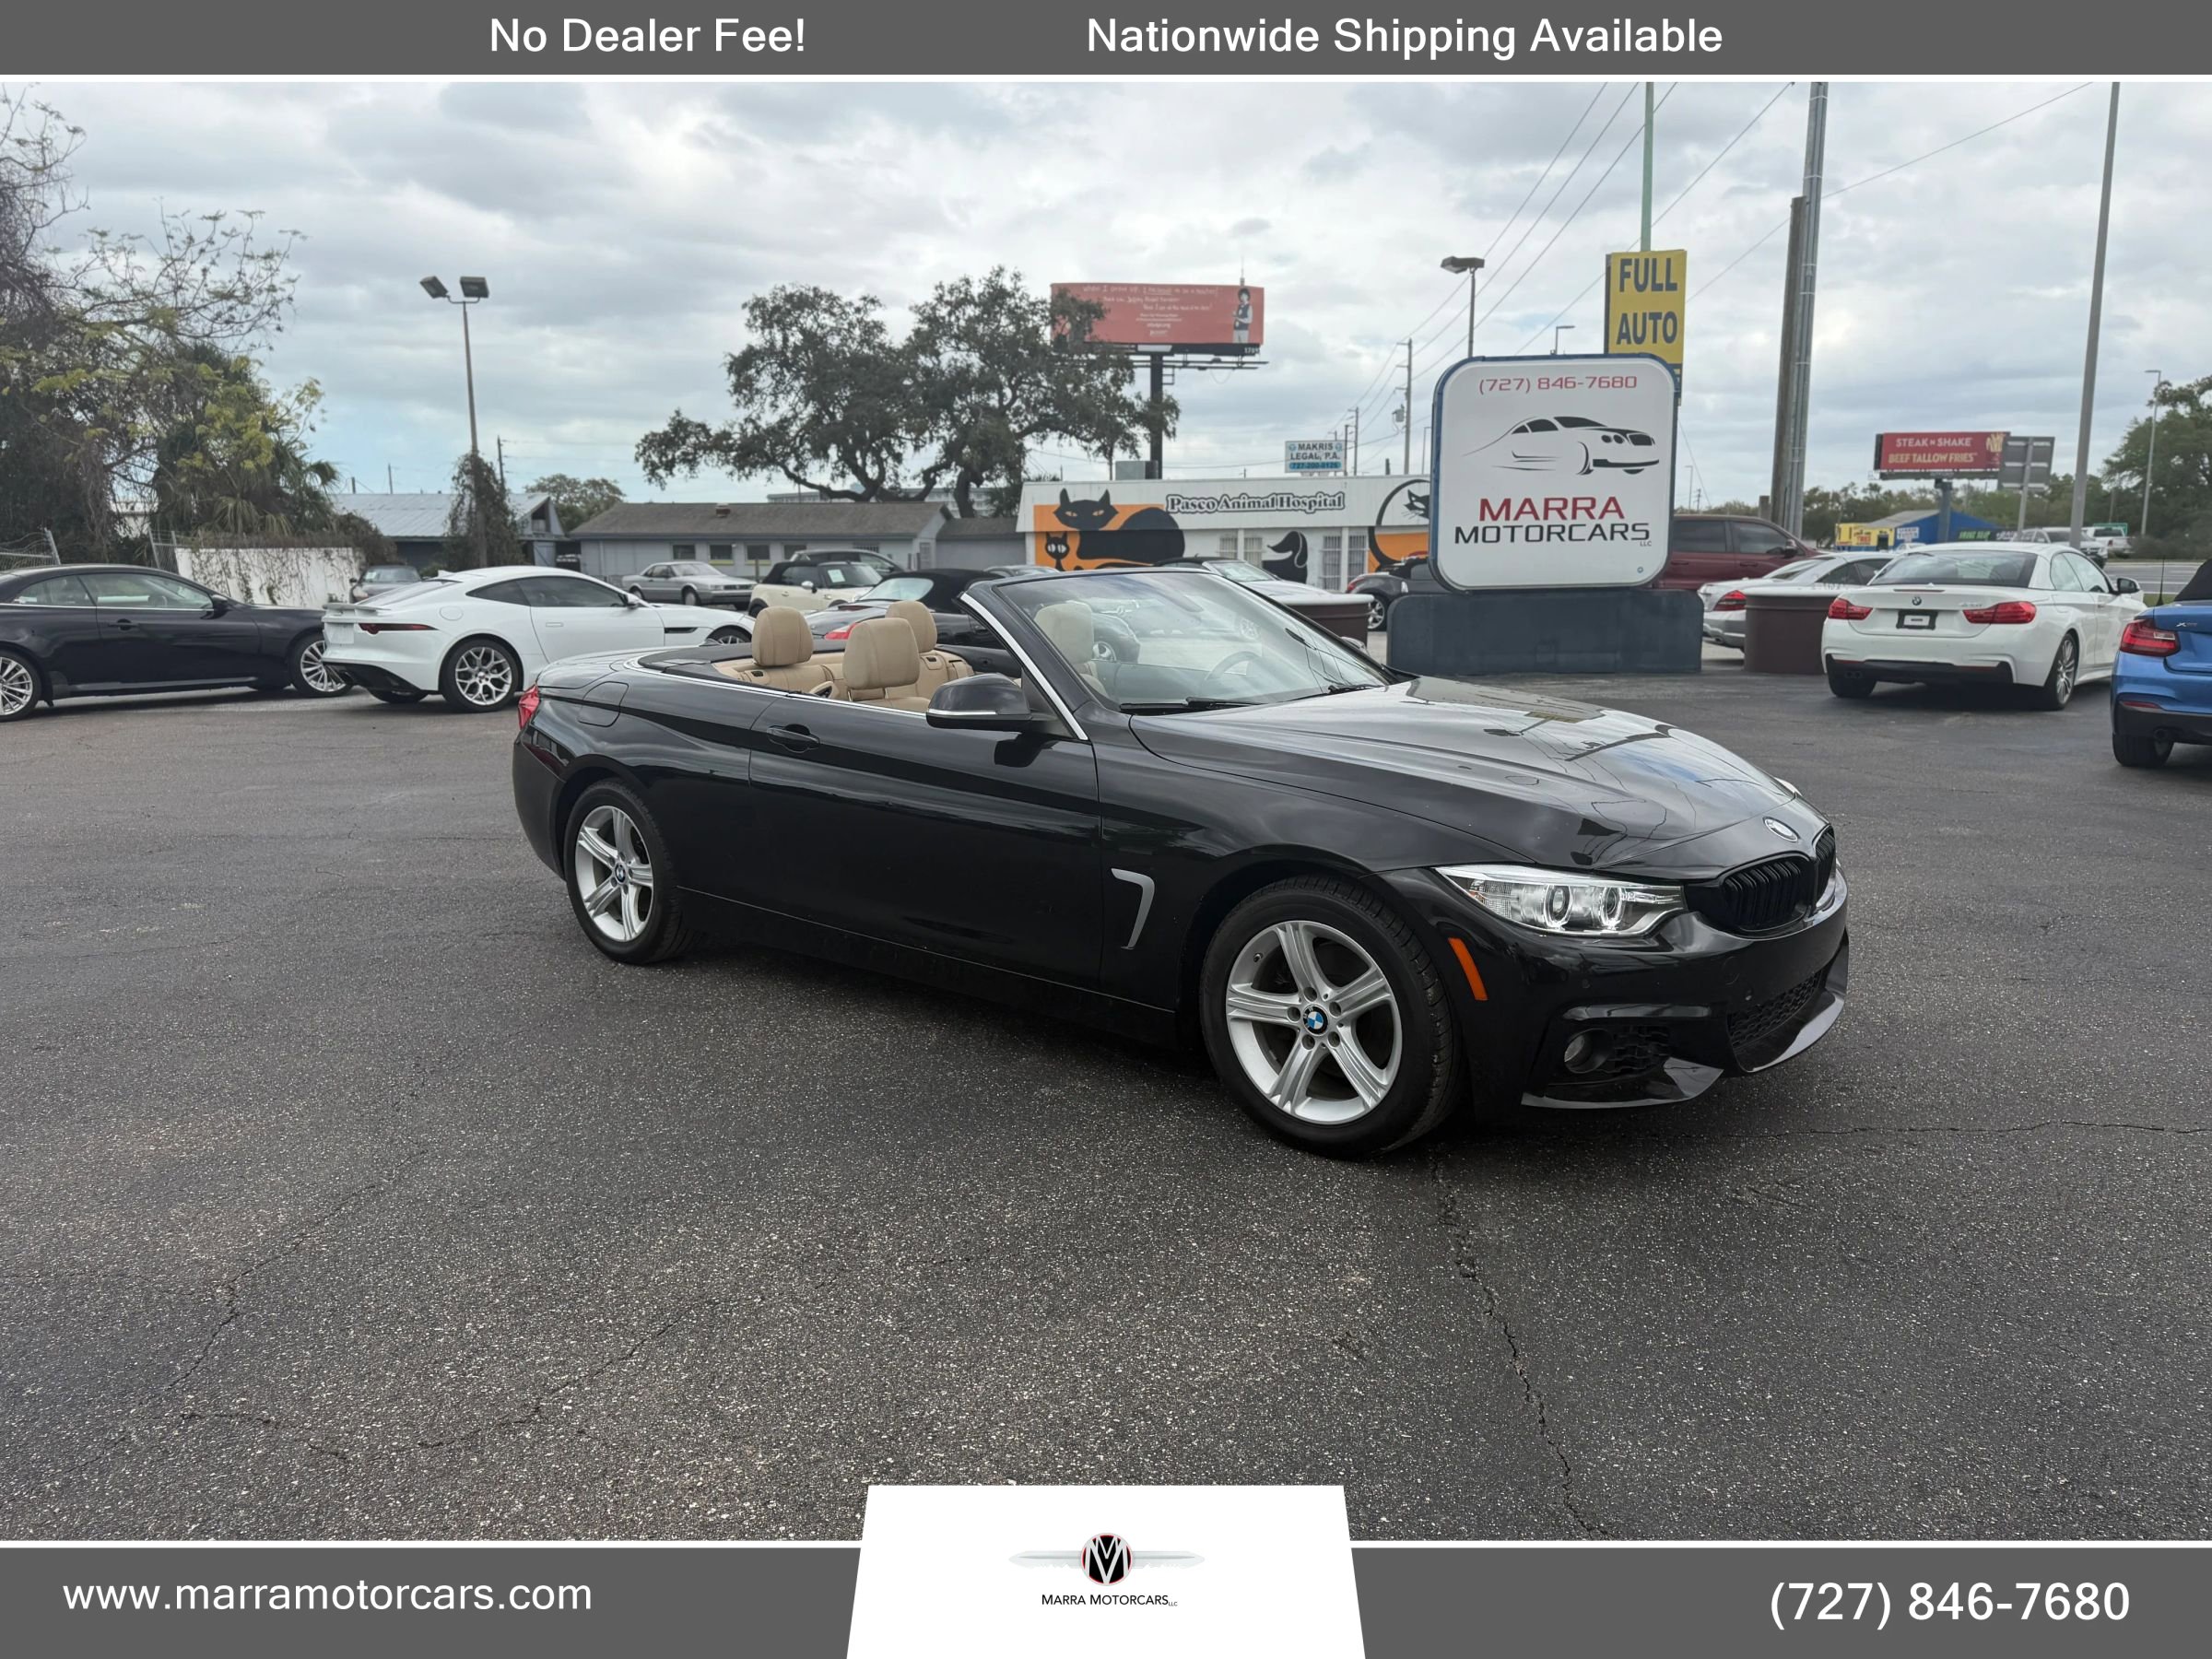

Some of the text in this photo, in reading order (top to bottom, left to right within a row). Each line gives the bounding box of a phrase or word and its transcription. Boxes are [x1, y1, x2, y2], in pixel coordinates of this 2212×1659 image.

[1618, 257, 1677, 293] FULL
[1616, 311, 1677, 346] AUTO
[1478, 376, 1638, 394] (727) 846-7680
[1298, 442, 1333, 451] MAKRIS
[1896, 438, 1928, 447] STEAK
[1936, 438, 1971, 447] SHAKE
[1290, 452, 1322, 460] LEGAL,
[1888, 453, 1974, 464] BEEF TALLOW FRIES
[1168, 492, 1344, 512] Pasco Animal Hospital
[1478, 496, 1625, 522] MARRA
[1454, 523, 1650, 544] MOTORCARS
